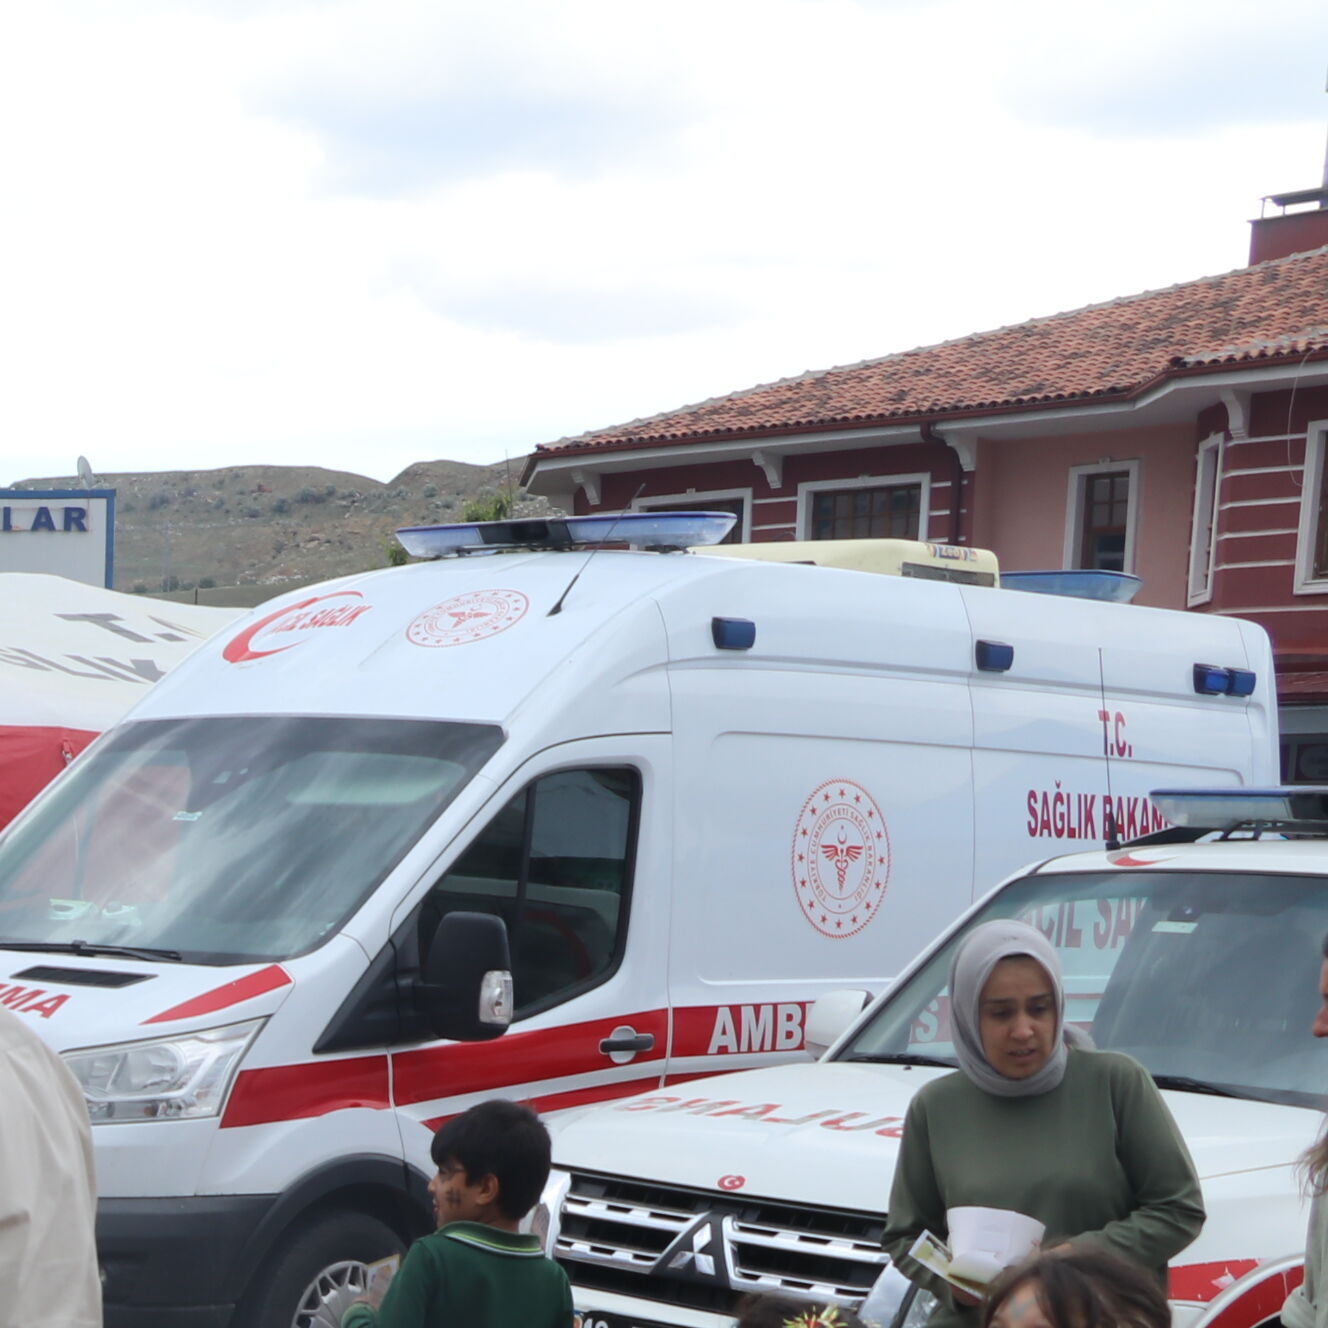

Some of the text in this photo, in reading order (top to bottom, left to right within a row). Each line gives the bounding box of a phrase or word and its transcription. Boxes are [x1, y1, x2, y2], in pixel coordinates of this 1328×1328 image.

[1097, 710, 1132, 758] T.C.
[849, 811, 871, 842] SAĞLIK
[1027, 779, 1169, 843] SAĞLIK BAKAN
